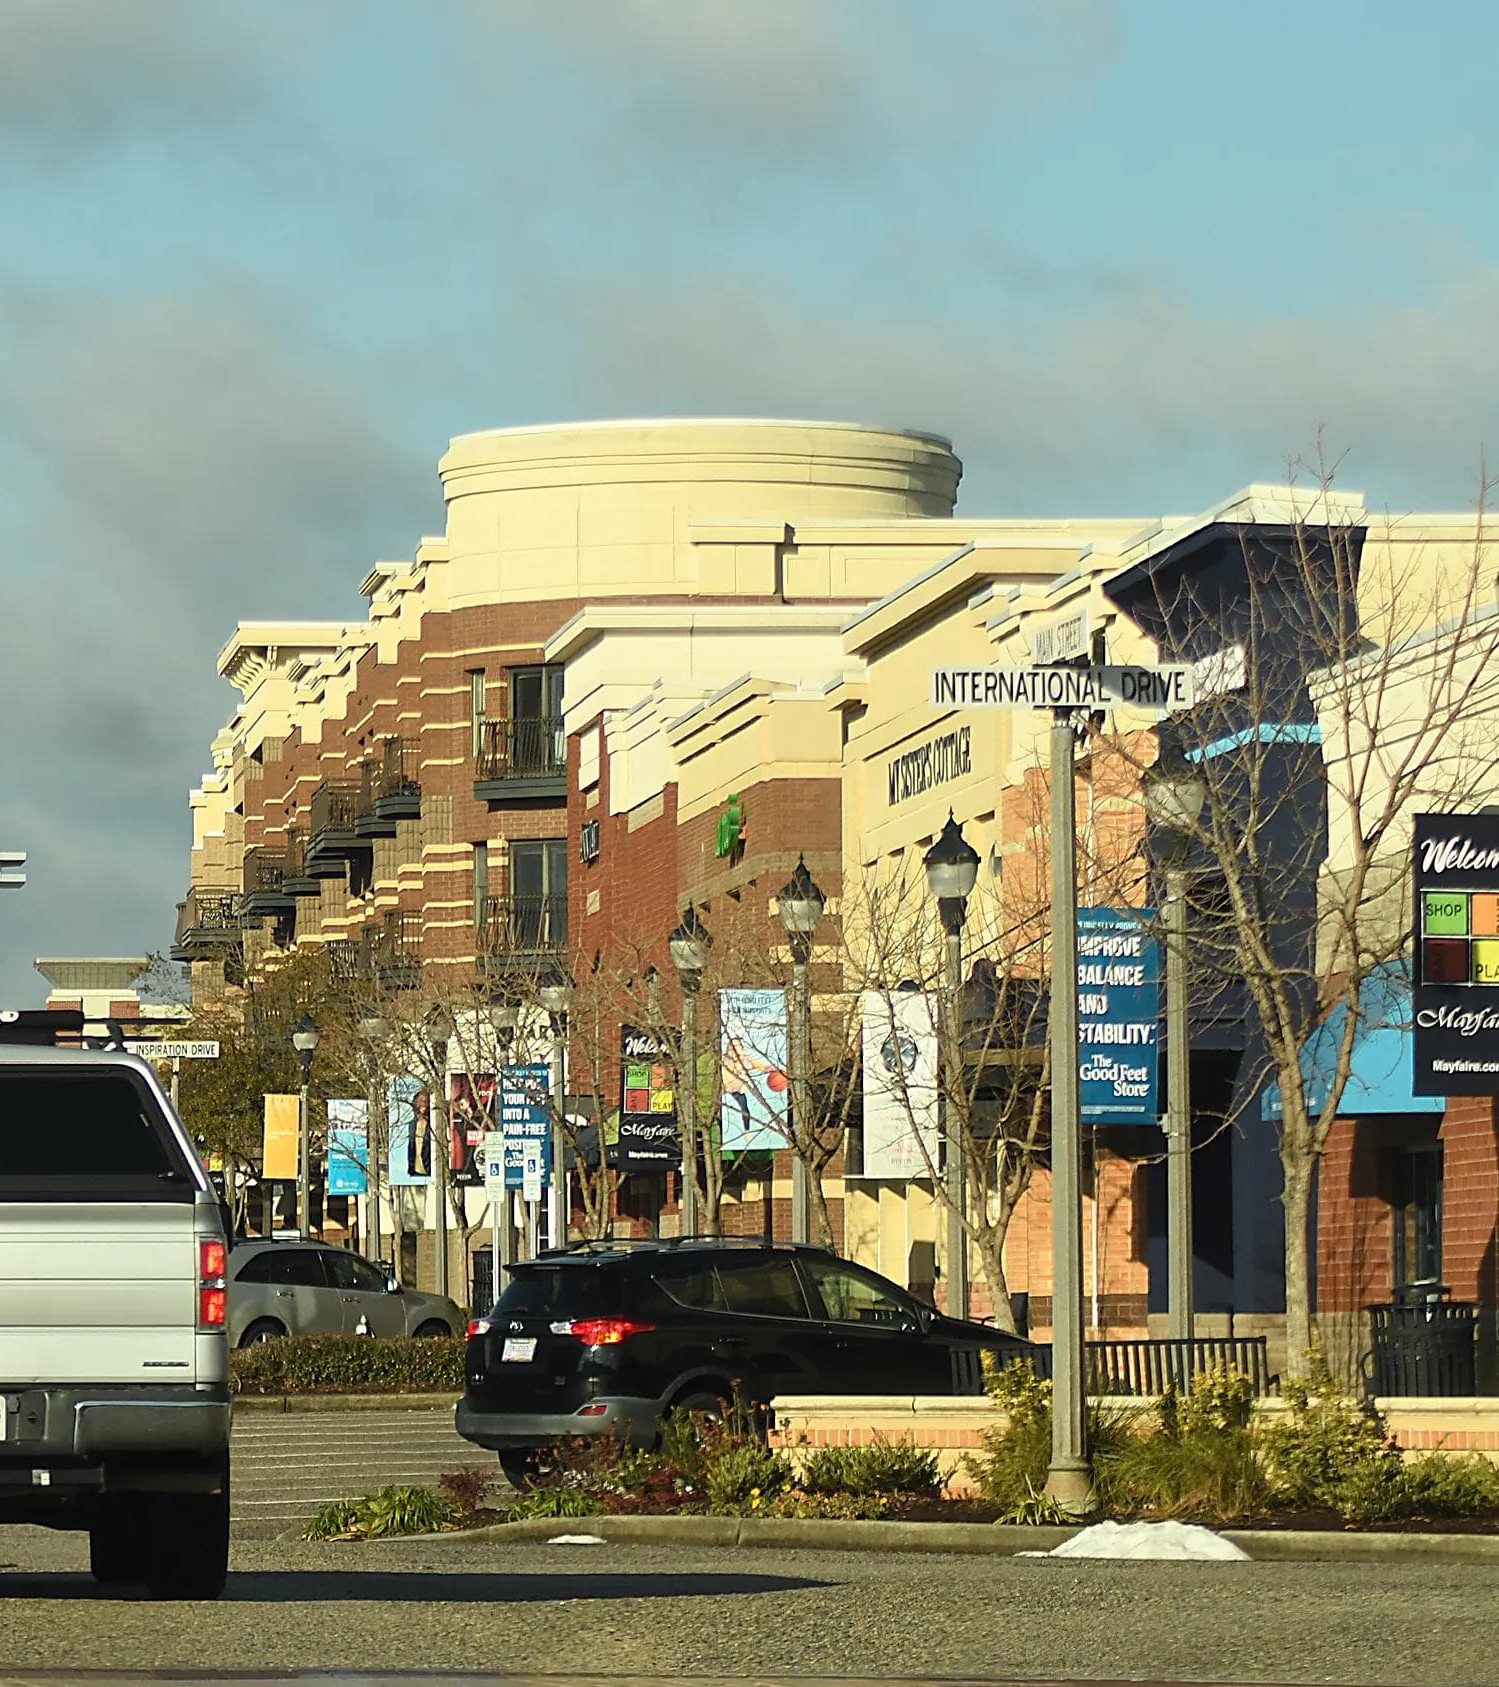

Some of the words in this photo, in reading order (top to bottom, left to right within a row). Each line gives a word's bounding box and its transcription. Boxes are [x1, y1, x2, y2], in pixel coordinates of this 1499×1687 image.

[1036, 627, 1054, 663] MAIN
[1057, 616, 1082, 657] STREET
[934, 671, 1112, 704] INTERNATIONAL
[1121, 671, 1186, 704] DRIVE
[933, 725, 972, 786] COTTAGE
[1426, 904, 1462, 917] SHOP
[1077, 935, 1142, 957] IMPROVE
[1078, 965, 1145, 985] BALANCE
[1079, 994, 1108, 1014] AND
[136, 1044, 188, 1056] INSPIRATION
[191, 1044, 216, 1056] DRIVE
[1091, 1054, 1112, 1069] The
[1432, 1060, 1499, 1074] Mayfaire.co
[627, 1070, 646, 1078] SHOP
[1080, 1063, 1118, 1082] Good
[1118, 1063, 1150, 1082] Feet
[1113, 1080, 1151, 1097] Store
[502, 1093, 526, 1106] YOUR
[503, 1108, 522, 1121] INTO
[502, 1122, 547, 1136] PAIN-FREE
[621, 1123, 675, 1140] Mayfaire
